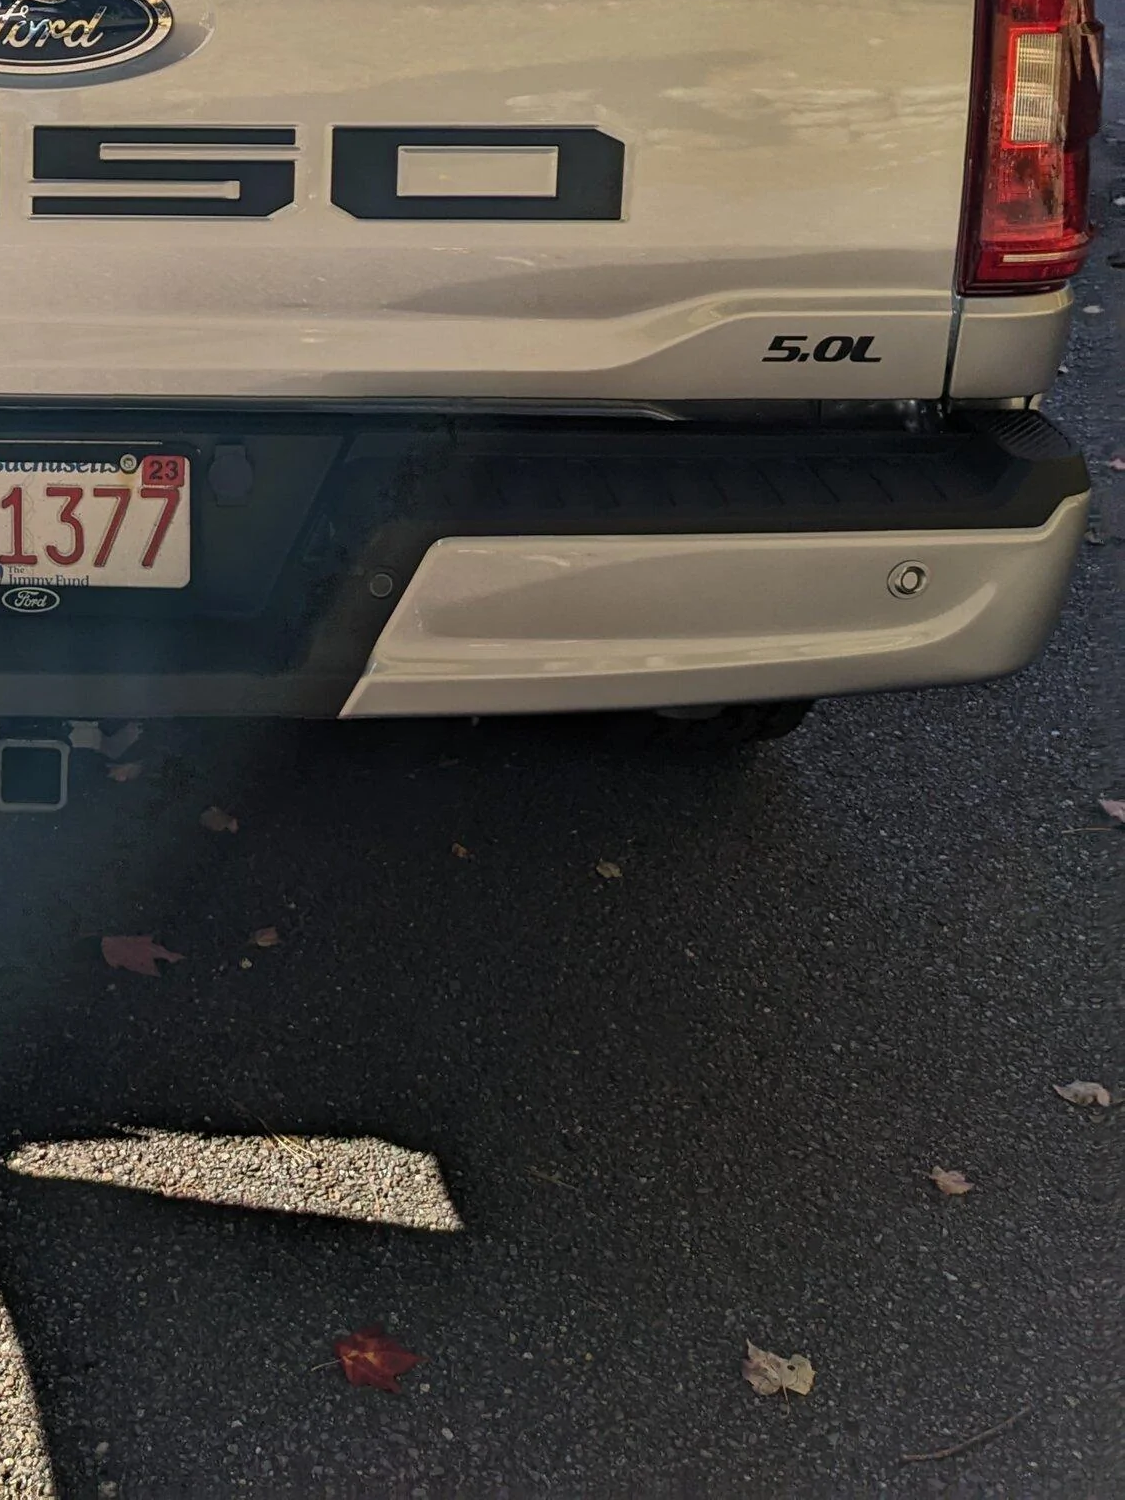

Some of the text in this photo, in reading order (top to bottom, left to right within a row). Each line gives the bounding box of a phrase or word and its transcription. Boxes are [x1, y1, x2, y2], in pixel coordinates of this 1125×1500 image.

[761, 335, 882, 363] 5.0L
[148, 460, 179, 481] 23
[0, 486, 181, 569] 1377
[8, 565, 25, 574] The
[8, 574, 90, 587] Jimmy Fund
[14, 590, 48, 608] Ford
